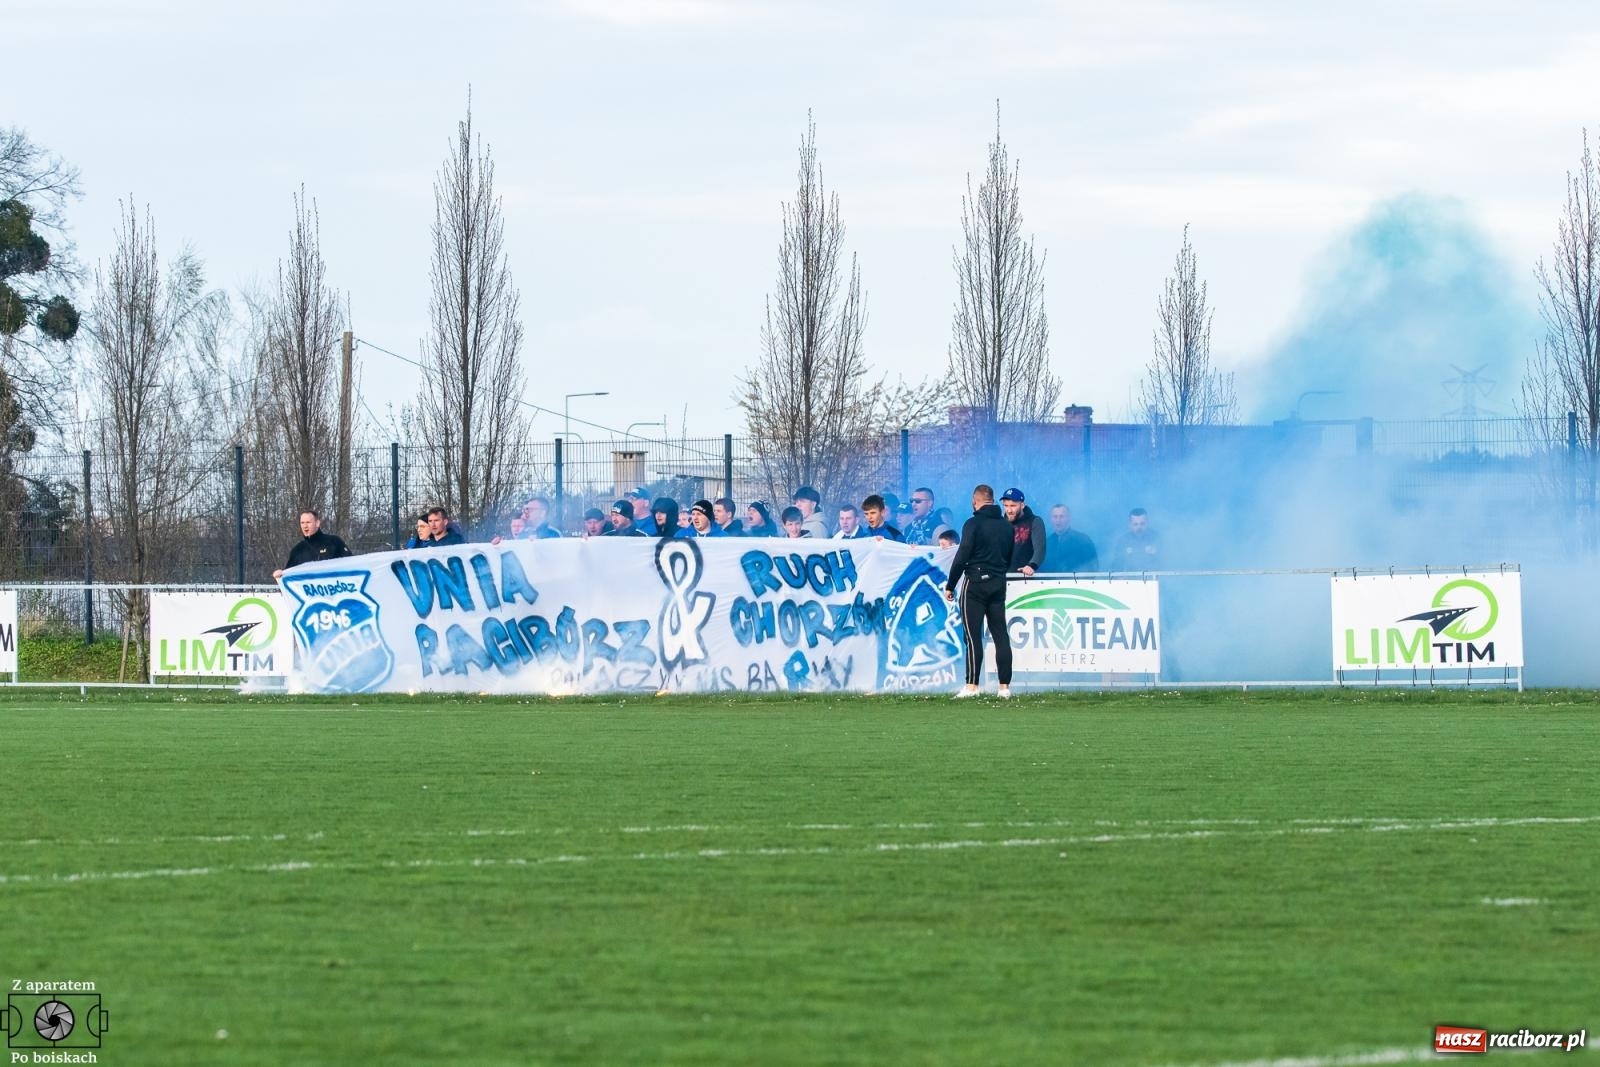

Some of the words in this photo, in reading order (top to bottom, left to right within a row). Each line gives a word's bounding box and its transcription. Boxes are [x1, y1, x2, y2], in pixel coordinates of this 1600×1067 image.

[391, 550, 539, 619] UNIA
[740, 549, 858, 598] RUCH
[306, 609, 352, 634] 1946
[655, 537, 716, 672] &
[1044, 653, 1096, 665] KIETRZ
